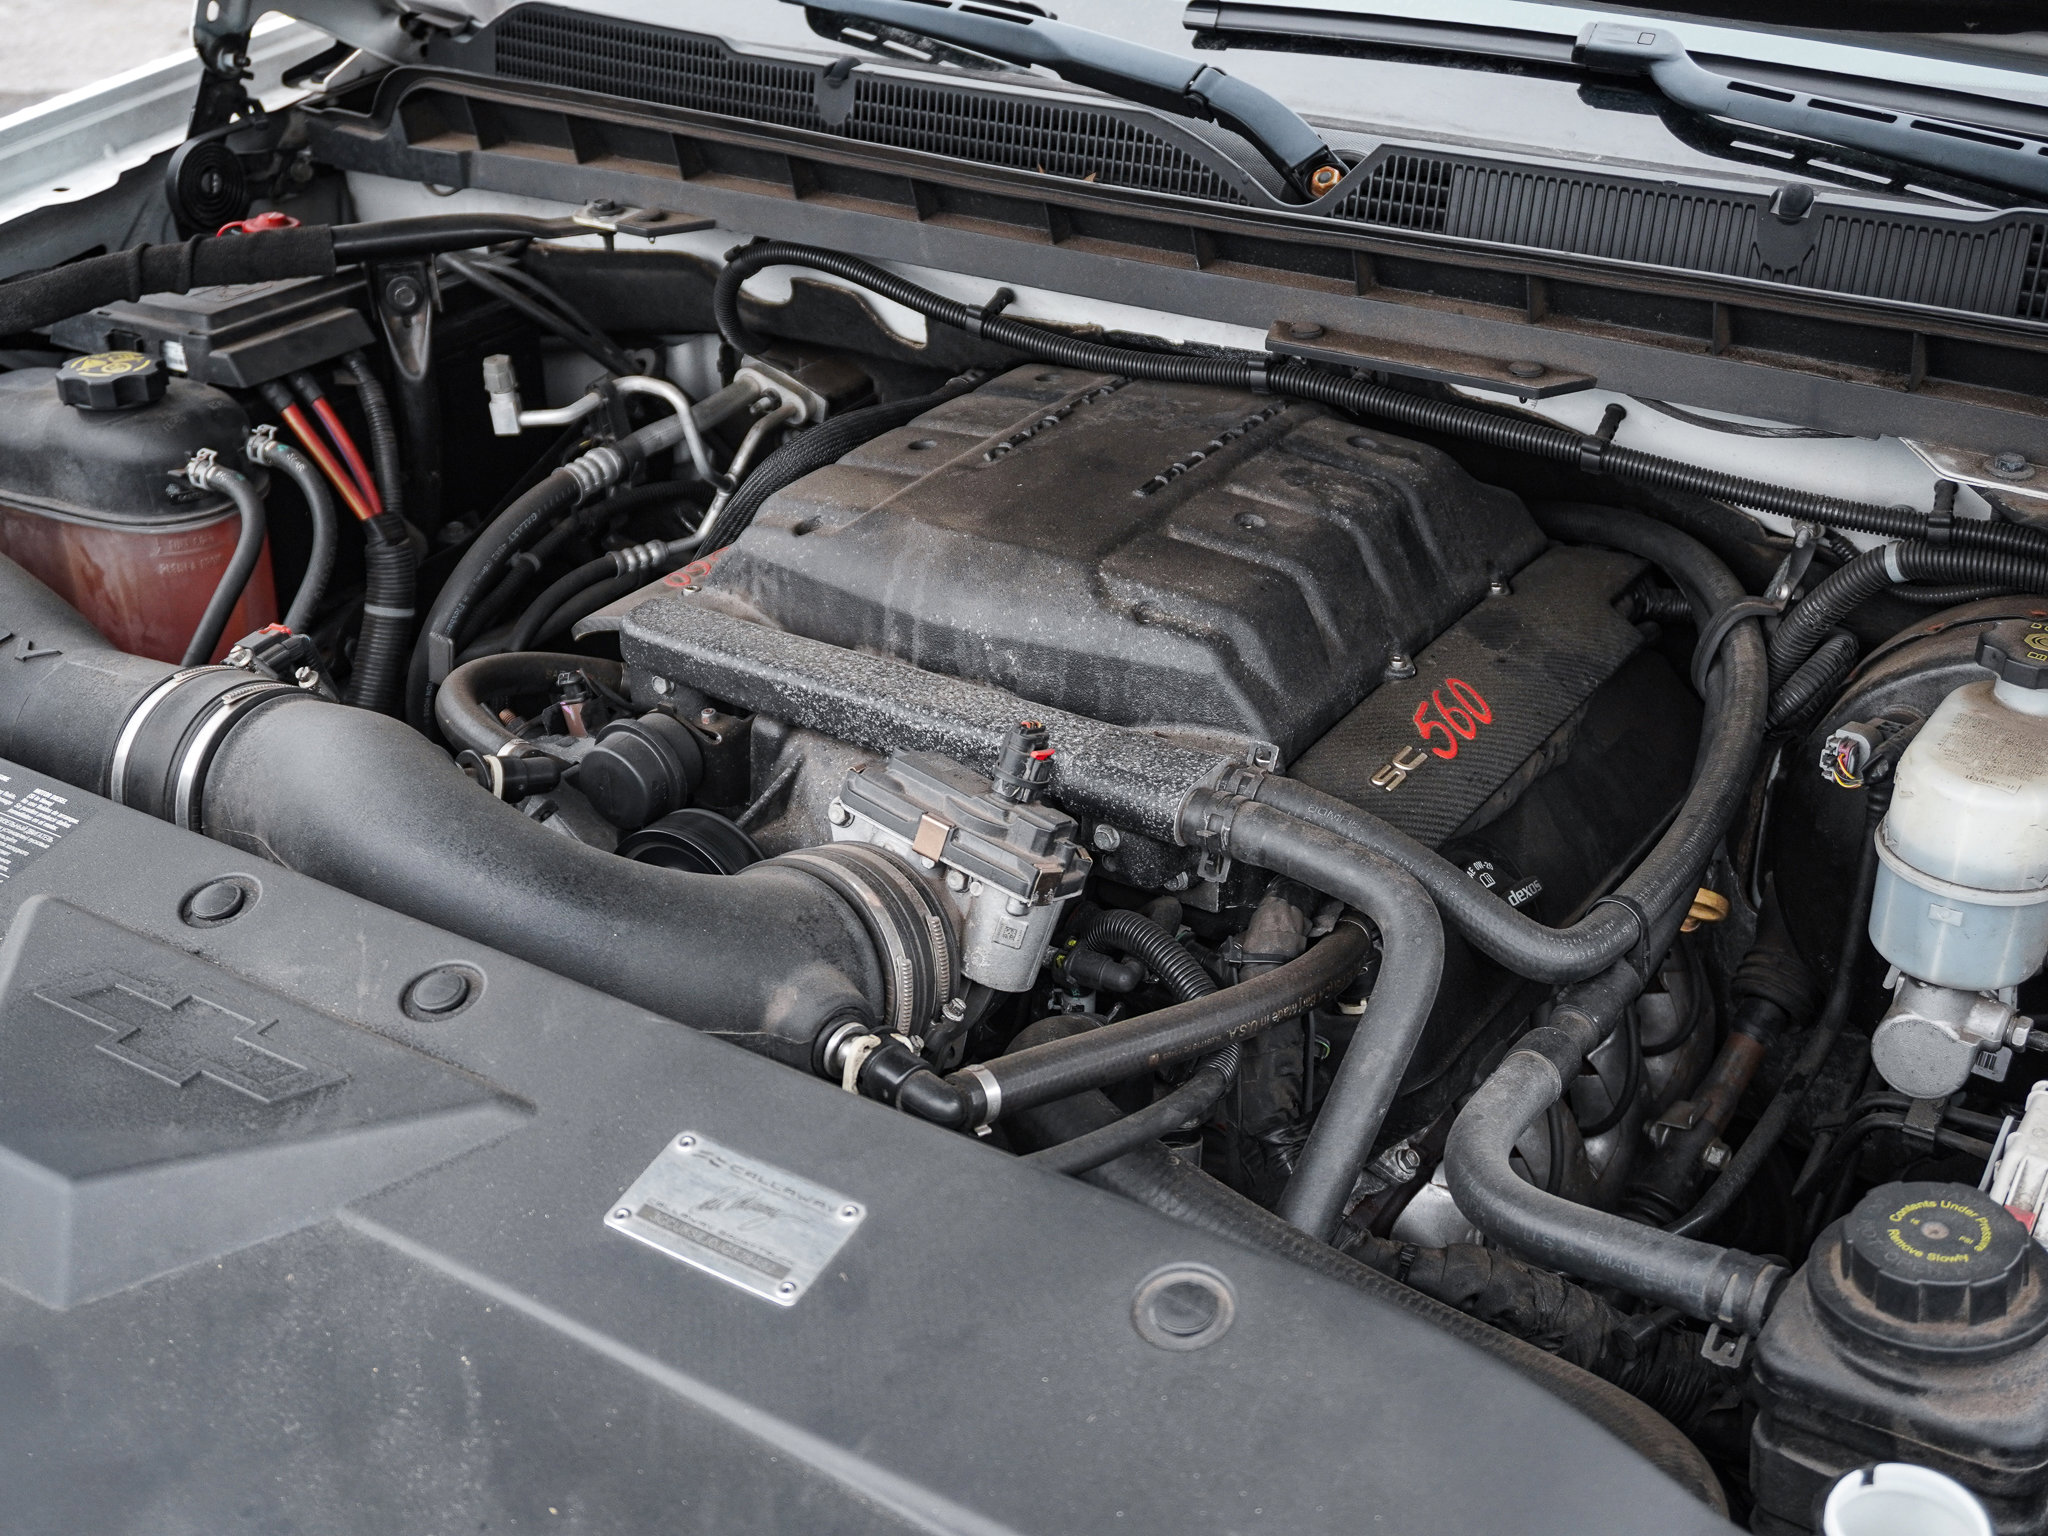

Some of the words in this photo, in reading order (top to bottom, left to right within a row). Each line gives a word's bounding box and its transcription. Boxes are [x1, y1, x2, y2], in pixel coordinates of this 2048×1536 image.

[1507, 880, 1543, 907] dexos
[1889, 1200, 1938, 1222] Contents
[1940, 1200, 1979, 1218] Under
[1975, 1216, 1992, 1252] Pressure
[1887, 1228, 1924, 1258] Remove
[1926, 1252, 1969, 1263] Slowly
